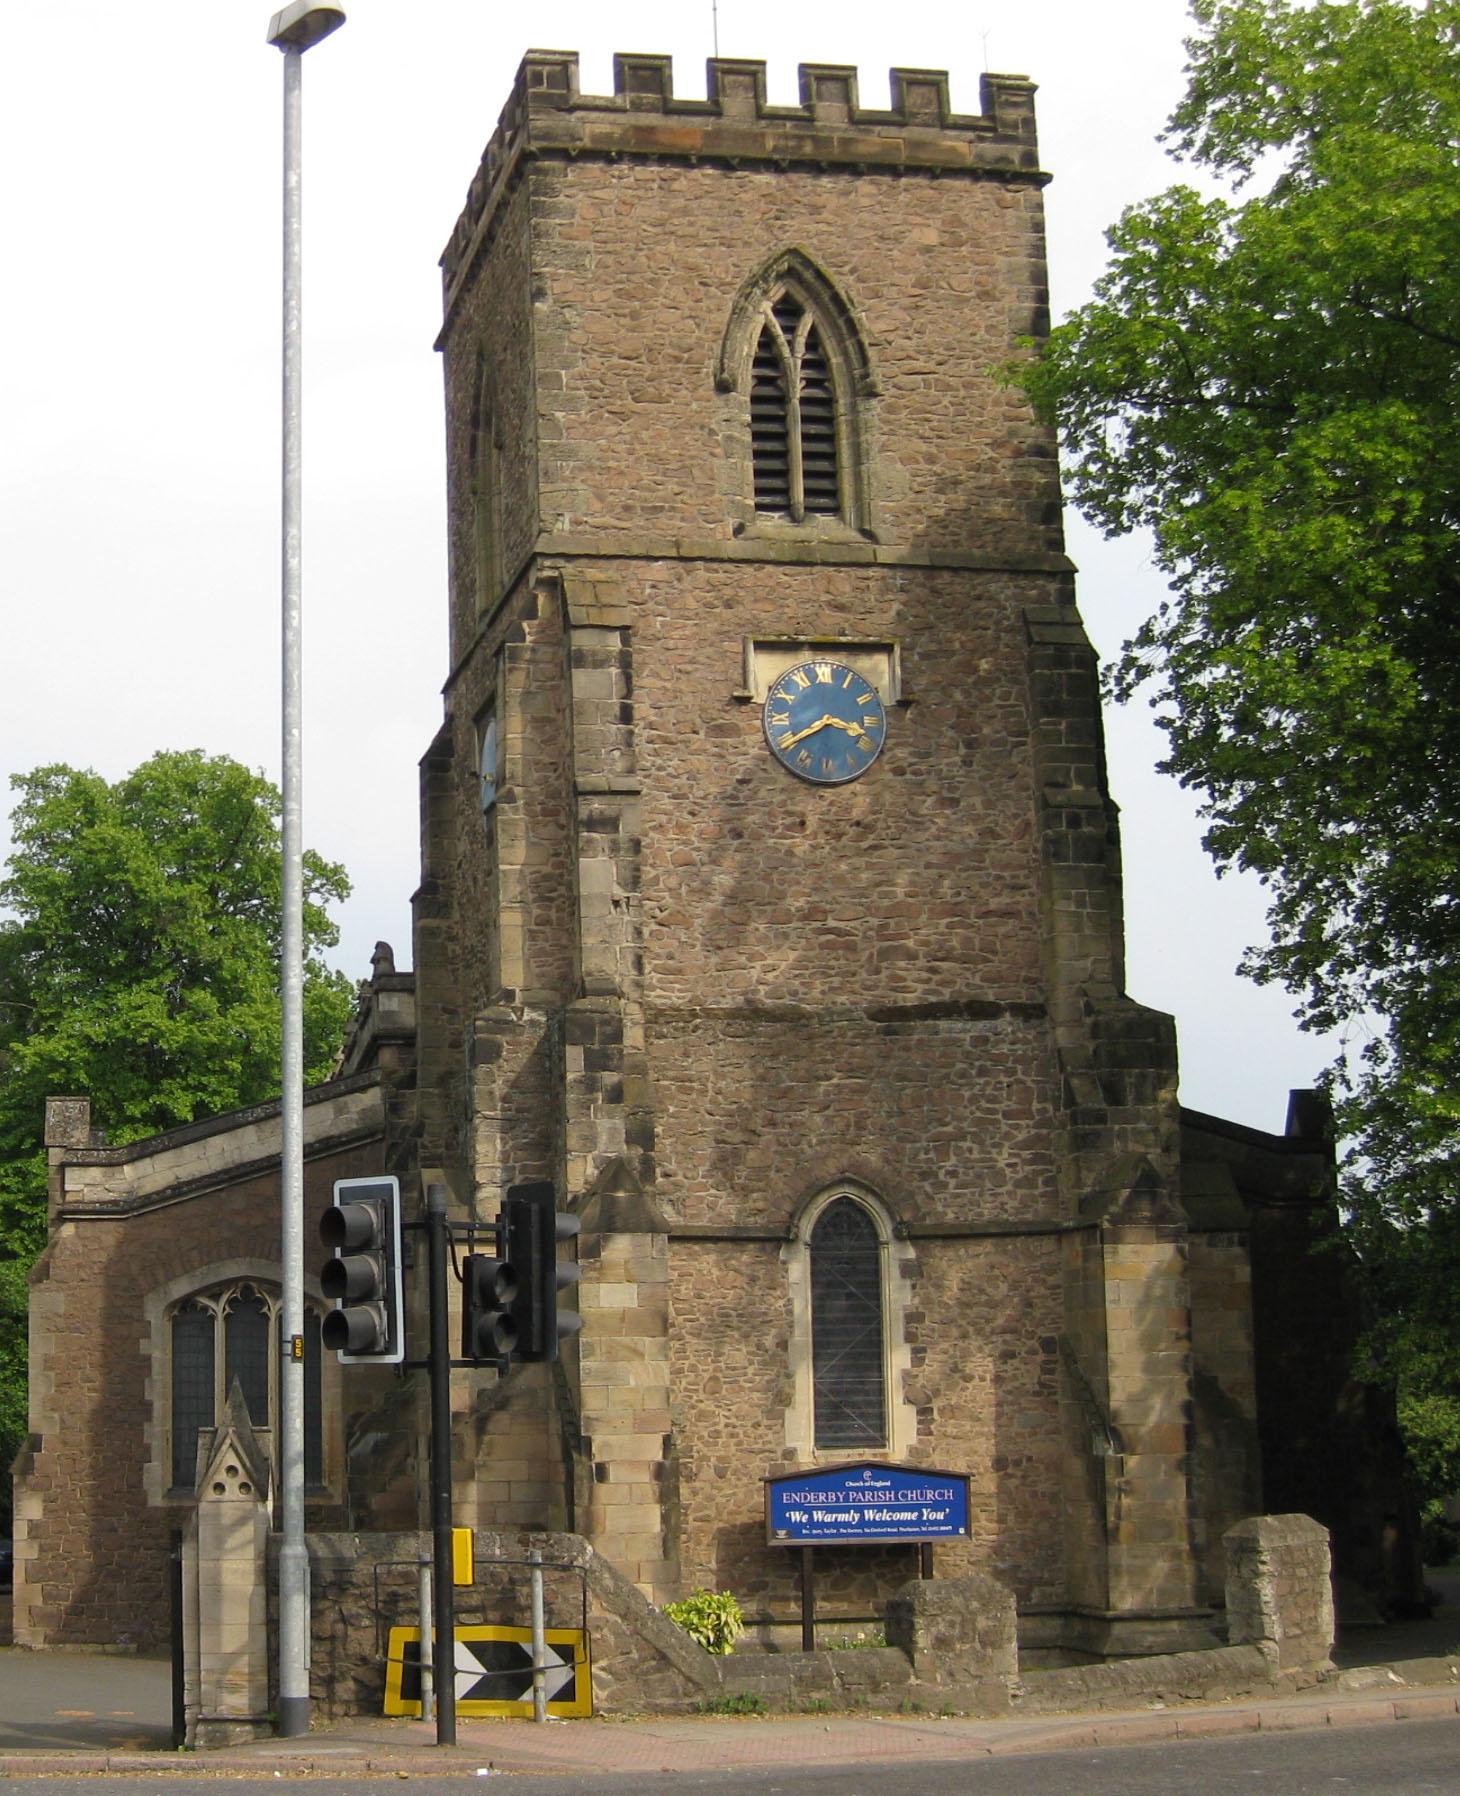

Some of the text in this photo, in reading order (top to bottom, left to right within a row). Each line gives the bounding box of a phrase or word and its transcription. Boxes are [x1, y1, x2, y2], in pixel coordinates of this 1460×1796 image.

[792, 671, 811, 690] XI
[815, 666, 833, 684] XII
[776, 689, 796, 704] X
[772, 711, 790, 726] IX
[782, 1488, 954, 1504] ENDERBY PARISH CHURCH
[812, 1509, 861, 1525] Warmly
[863, 1508, 919, 1521] Welcome
